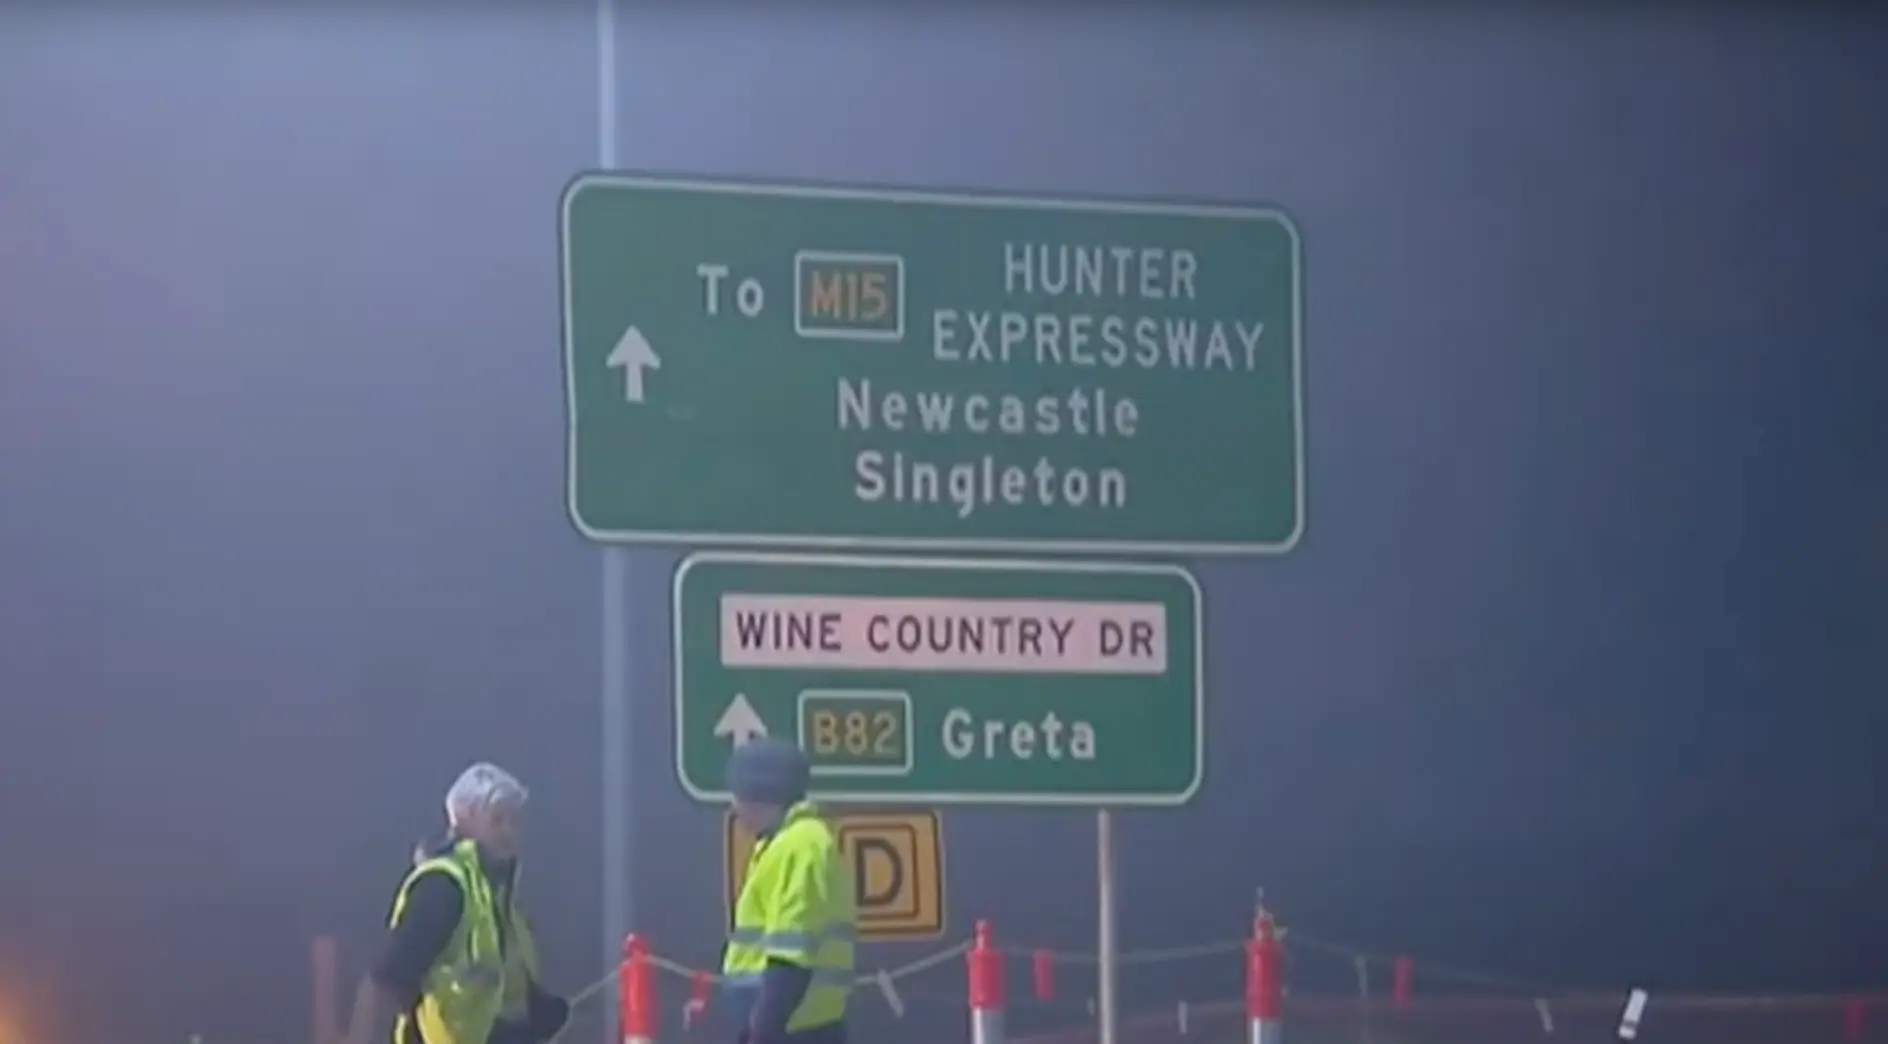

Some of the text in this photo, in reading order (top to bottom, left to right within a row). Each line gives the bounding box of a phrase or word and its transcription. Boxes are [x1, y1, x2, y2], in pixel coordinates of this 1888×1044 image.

[698, 264, 888, 320] To M15
[1004, 242, 1197, 299] HUNTER
[933, 310, 1264, 371] EXPRESSWAY
[837, 378, 1139, 436] Newcastle
[853, 451, 1127, 517] Singleton
[736, 611, 1154, 657] WINE COUNTRY DR
[811, 707, 1096, 760] B82 Greta
[855, 837, 903, 909] D
